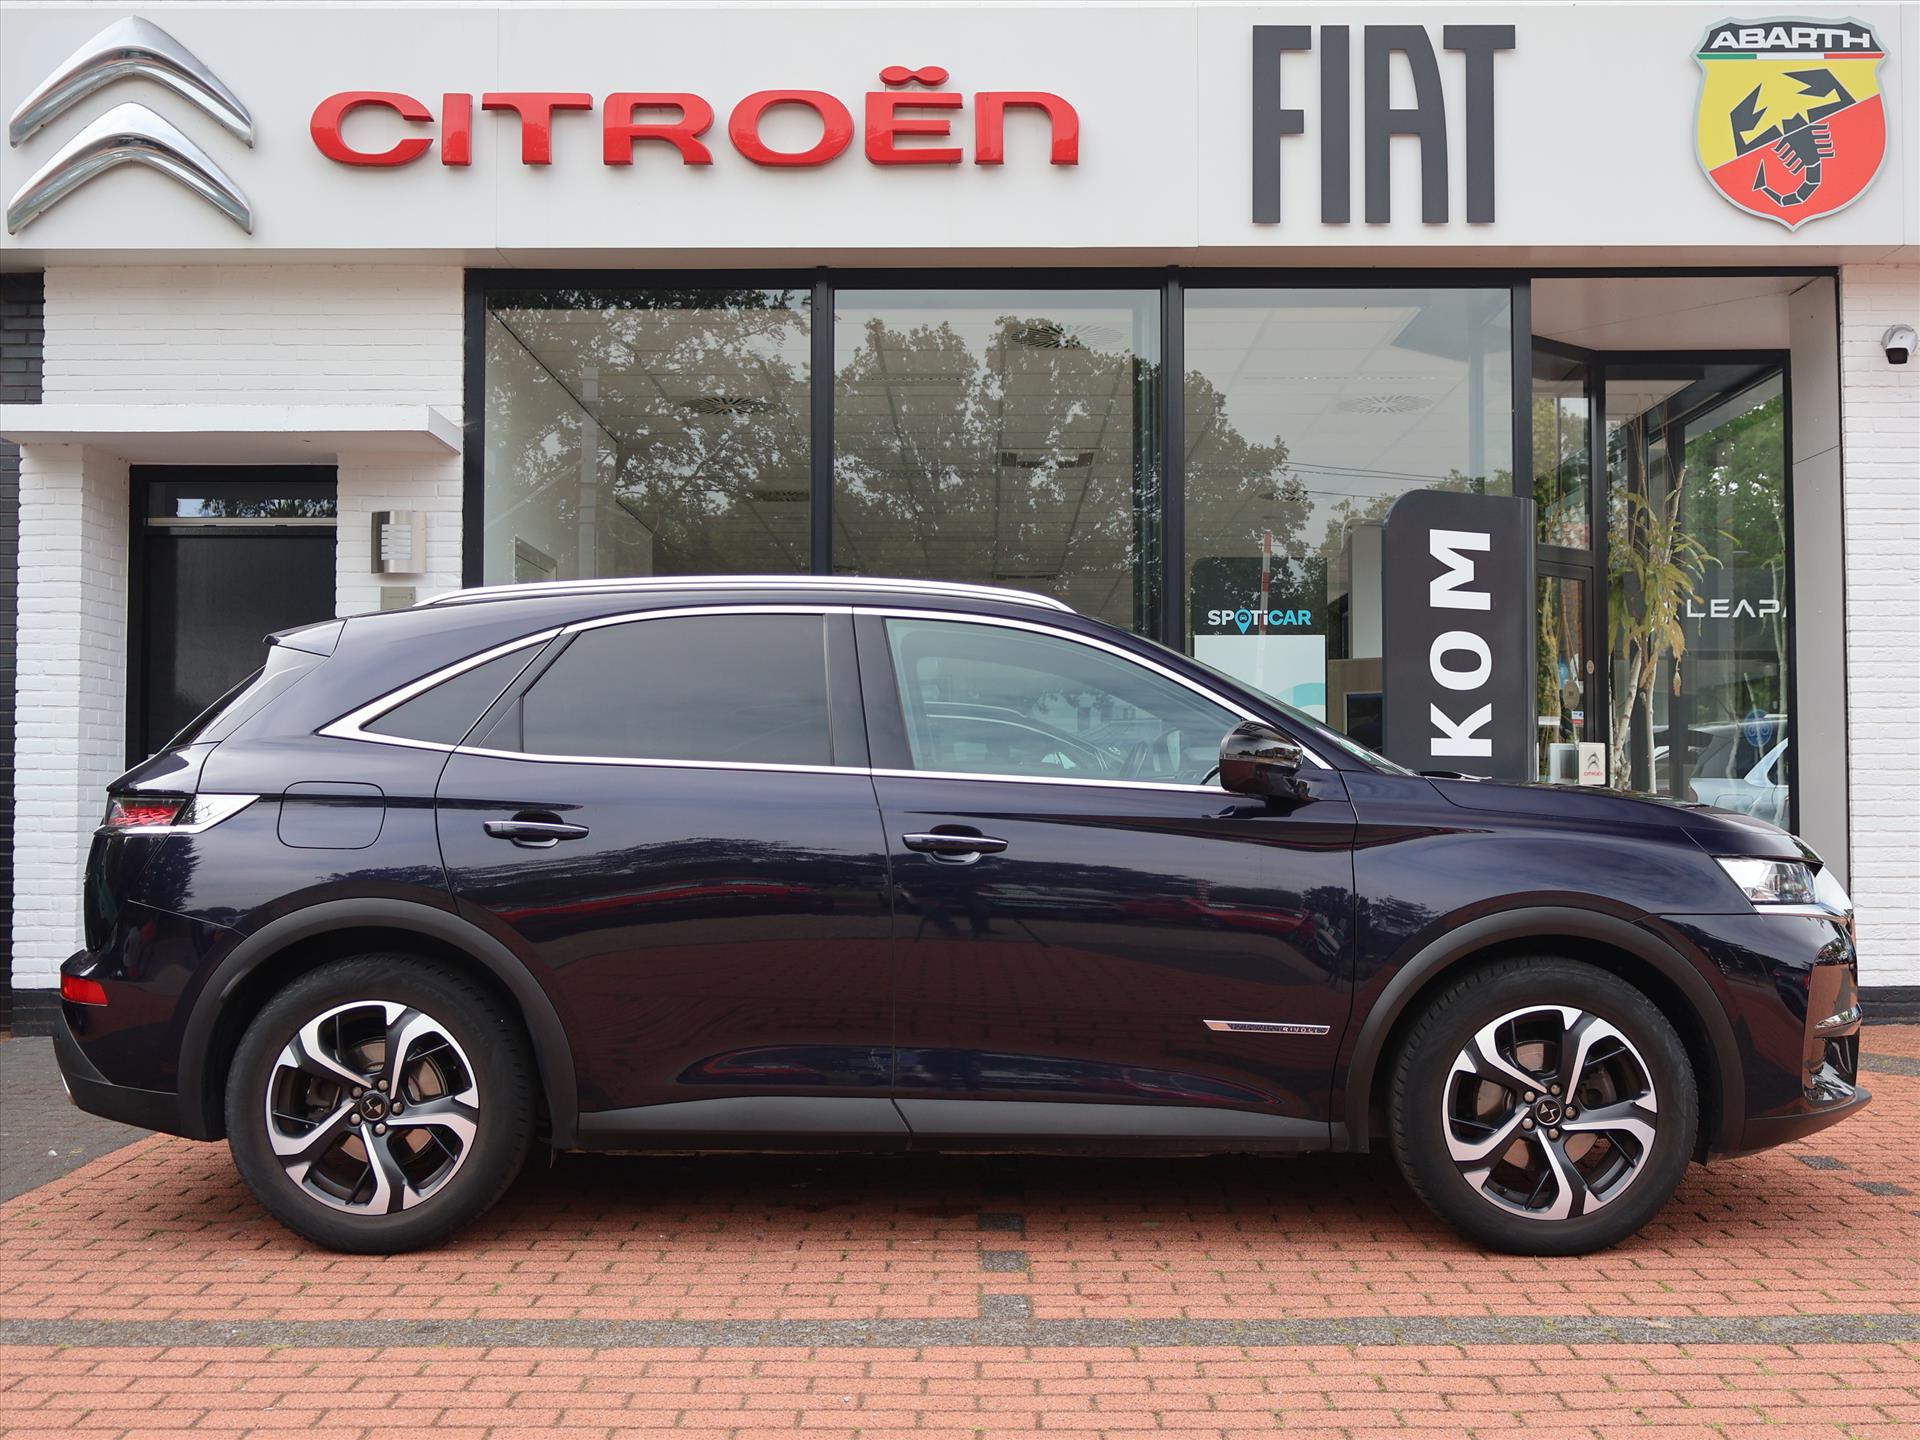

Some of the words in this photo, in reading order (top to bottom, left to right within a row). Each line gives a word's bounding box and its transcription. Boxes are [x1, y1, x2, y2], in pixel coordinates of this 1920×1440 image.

[1710, 26, 1870, 49] ABARTH
[1252, 24, 1516, 224] FIAT
[1429, 528, 1493, 757] KOM
[1686, 598, 1787, 618] LEAP
